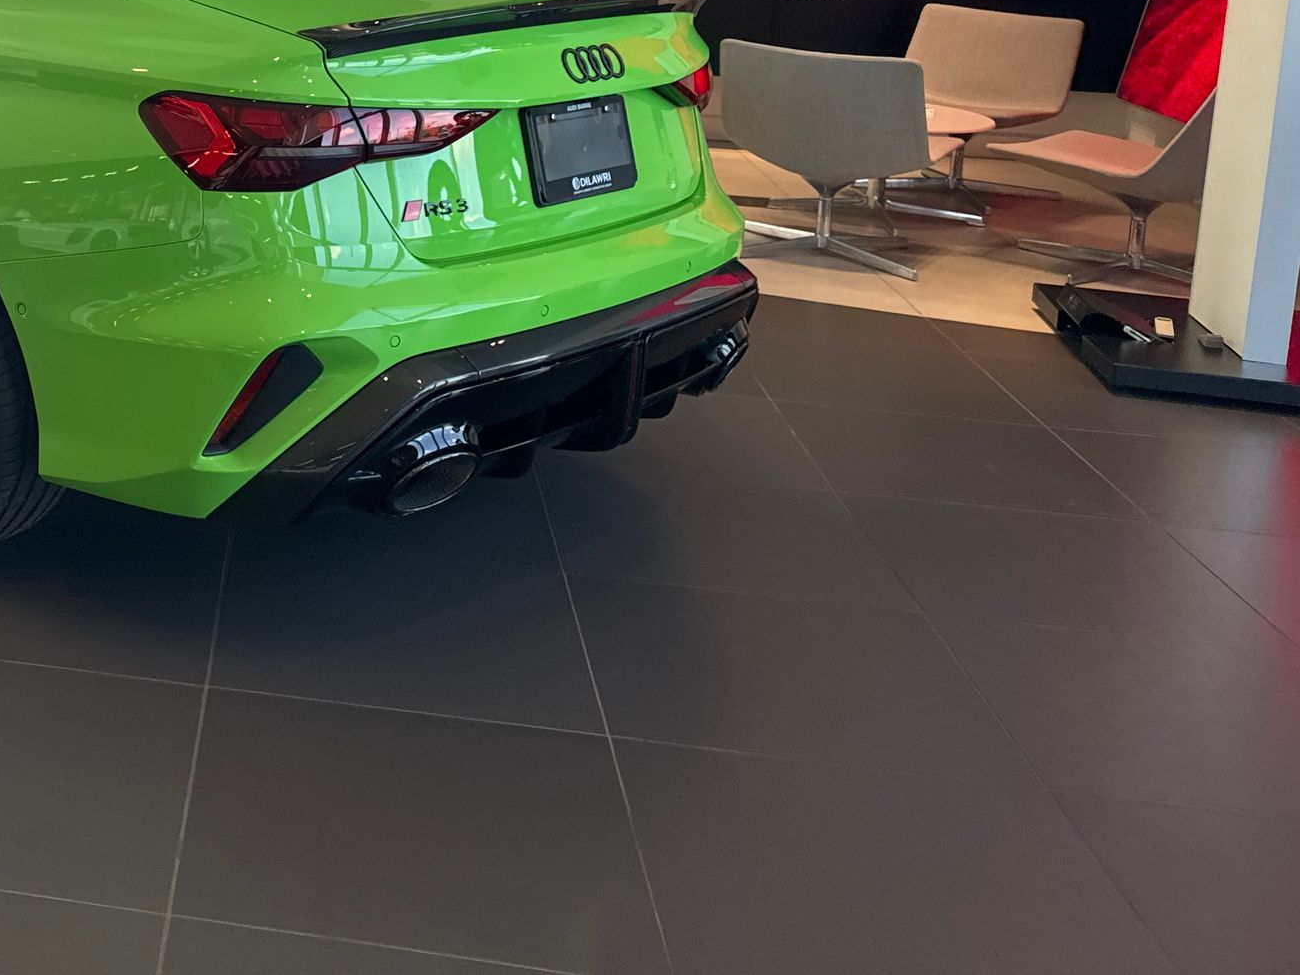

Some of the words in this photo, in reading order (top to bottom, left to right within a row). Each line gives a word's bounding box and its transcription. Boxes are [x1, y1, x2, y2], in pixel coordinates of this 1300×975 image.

[580, 171, 612, 188] DILAWRI
[424, 199, 453, 218] RS
[456, 197, 469, 214] 3
